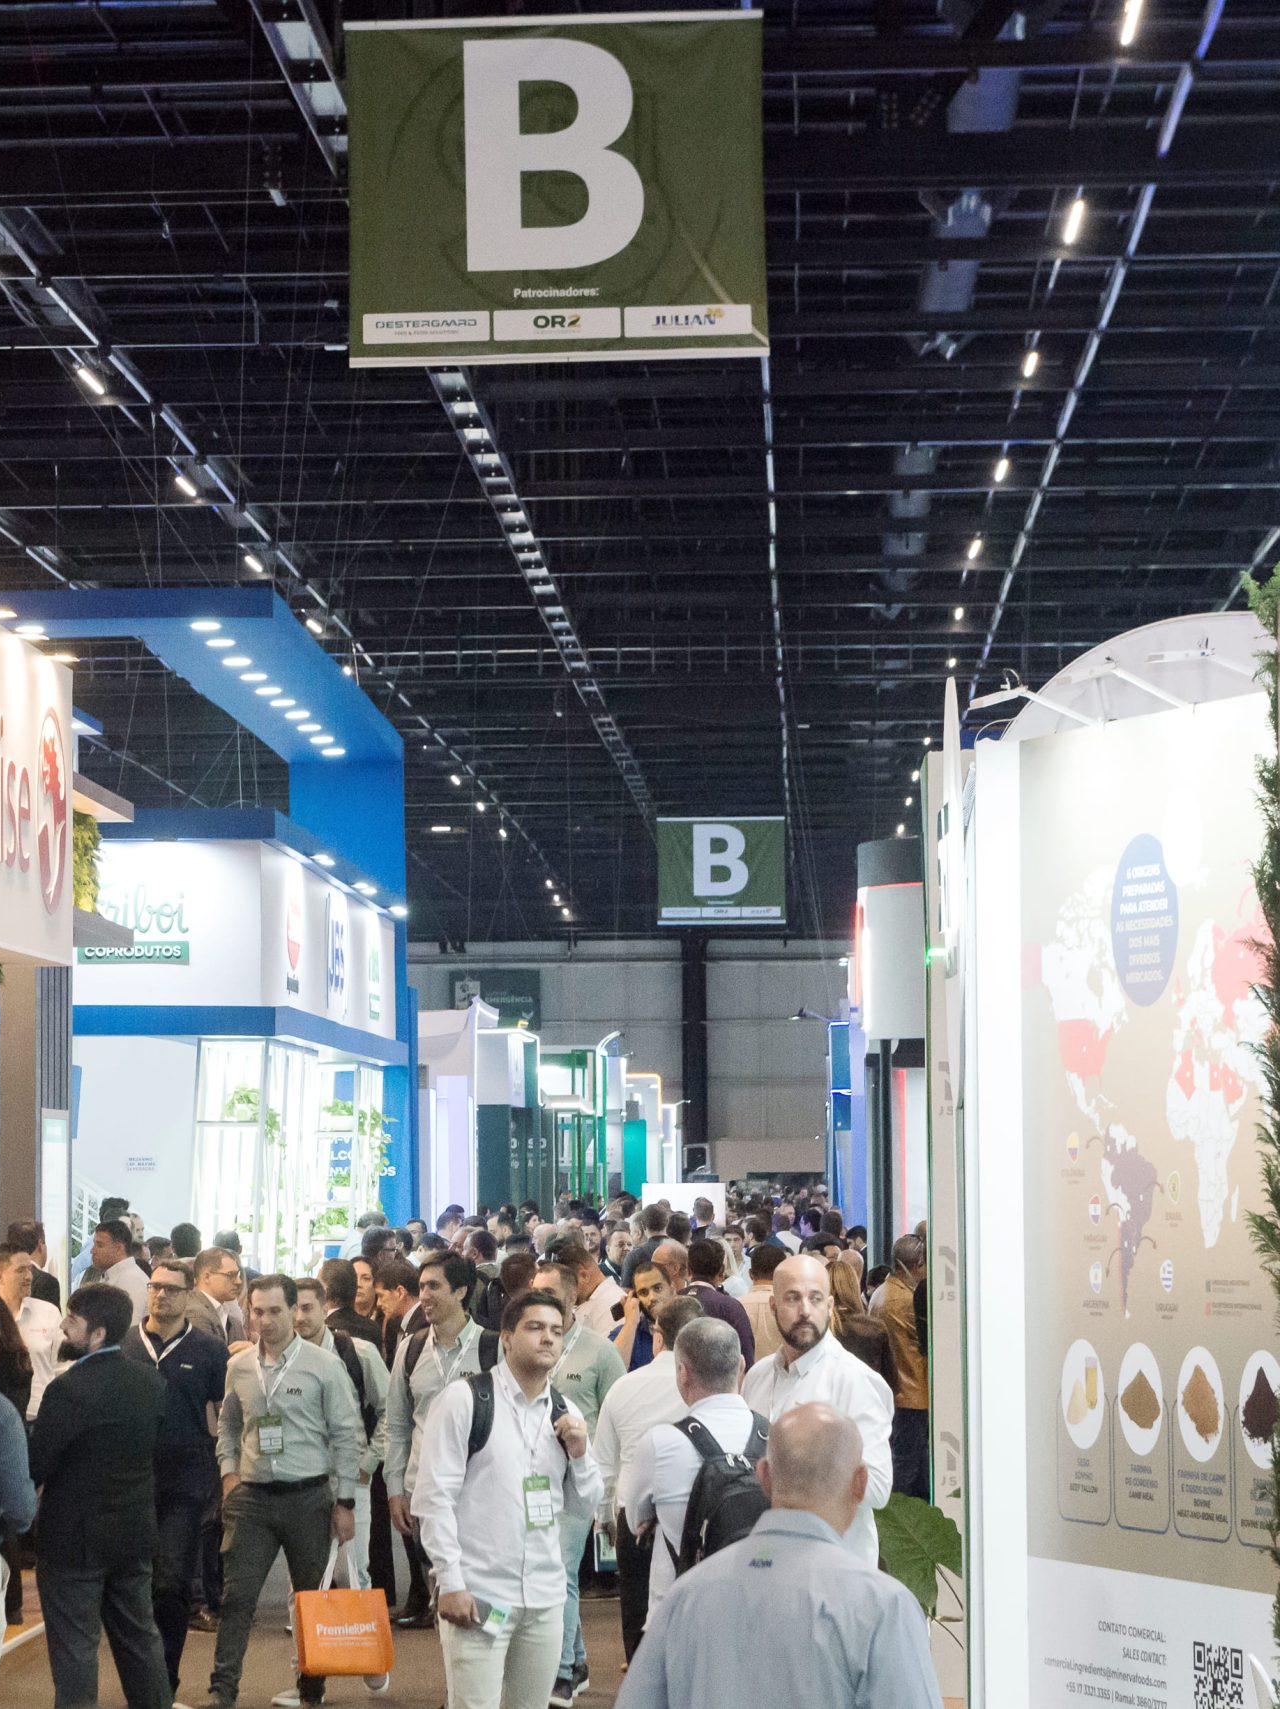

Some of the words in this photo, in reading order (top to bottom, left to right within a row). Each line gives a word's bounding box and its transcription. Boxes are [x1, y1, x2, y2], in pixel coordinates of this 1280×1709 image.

[463, 38, 645, 272] B
[513, 287, 600, 298] Patrocinadores:
[654, 314, 716, 327] JULIAN
[693, 823, 749, 896] B
[84, 946, 181, 958] COPRODUTOS
[328, 919, 345, 994] JBS
[1097, 1620, 1127, 1635] CONTATO
[1128, 1625, 1167, 1643] COMERCIAL:
[1122, 1647, 1140, 1660] SALES
[1140, 1650, 1167, 1666] CONTACT:
[1065, 1681, 1076, 1693] +55
[1115, 1691, 1135, 1705] Ramal:
